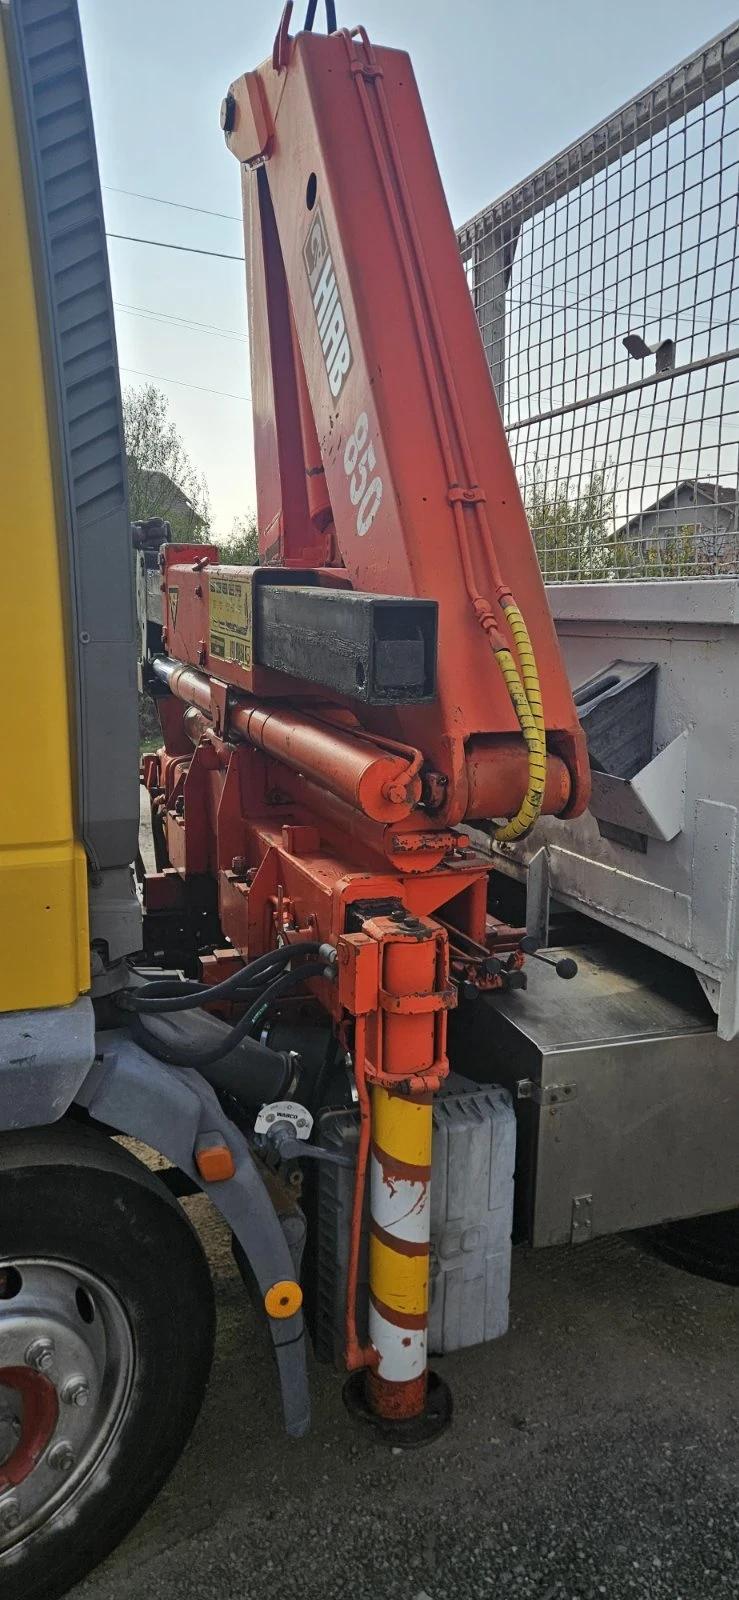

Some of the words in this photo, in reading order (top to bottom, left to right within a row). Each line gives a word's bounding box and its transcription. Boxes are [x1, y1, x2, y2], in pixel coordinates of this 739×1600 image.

[313, 254, 351, 397] HIAB
[343, 411, 383, 536] 850
[276, 1112, 298, 1120] WABCO
